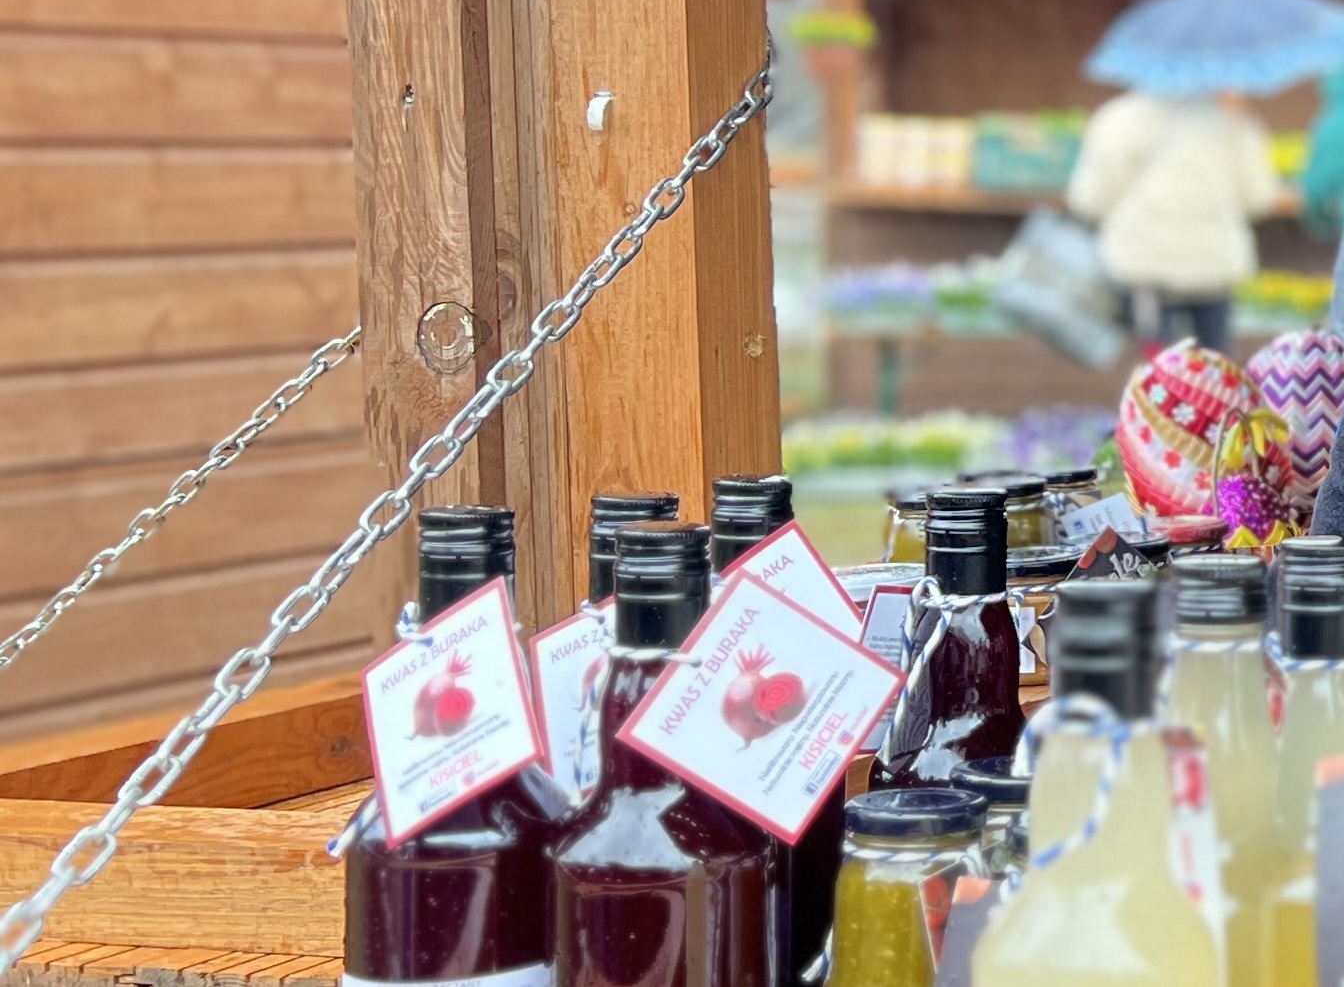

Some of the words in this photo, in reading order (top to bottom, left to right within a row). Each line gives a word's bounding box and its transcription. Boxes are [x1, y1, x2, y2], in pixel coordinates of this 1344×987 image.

[757, 555, 793, 581] AKA
[381, 659, 418, 694] KWAS
[420, 652, 429, 666] Z
[431, 615, 488, 659] BURAKA
[551, 634, 589, 665] KWAS
[591, 629, 600, 645] Z
[659, 686, 700, 736] KWAS
[696, 671, 712, 688] Z
[705, 606, 761, 674] BURAKA
[799, 712, 849, 770] KISICIEL
[428, 749, 484, 789] KISICIEL
